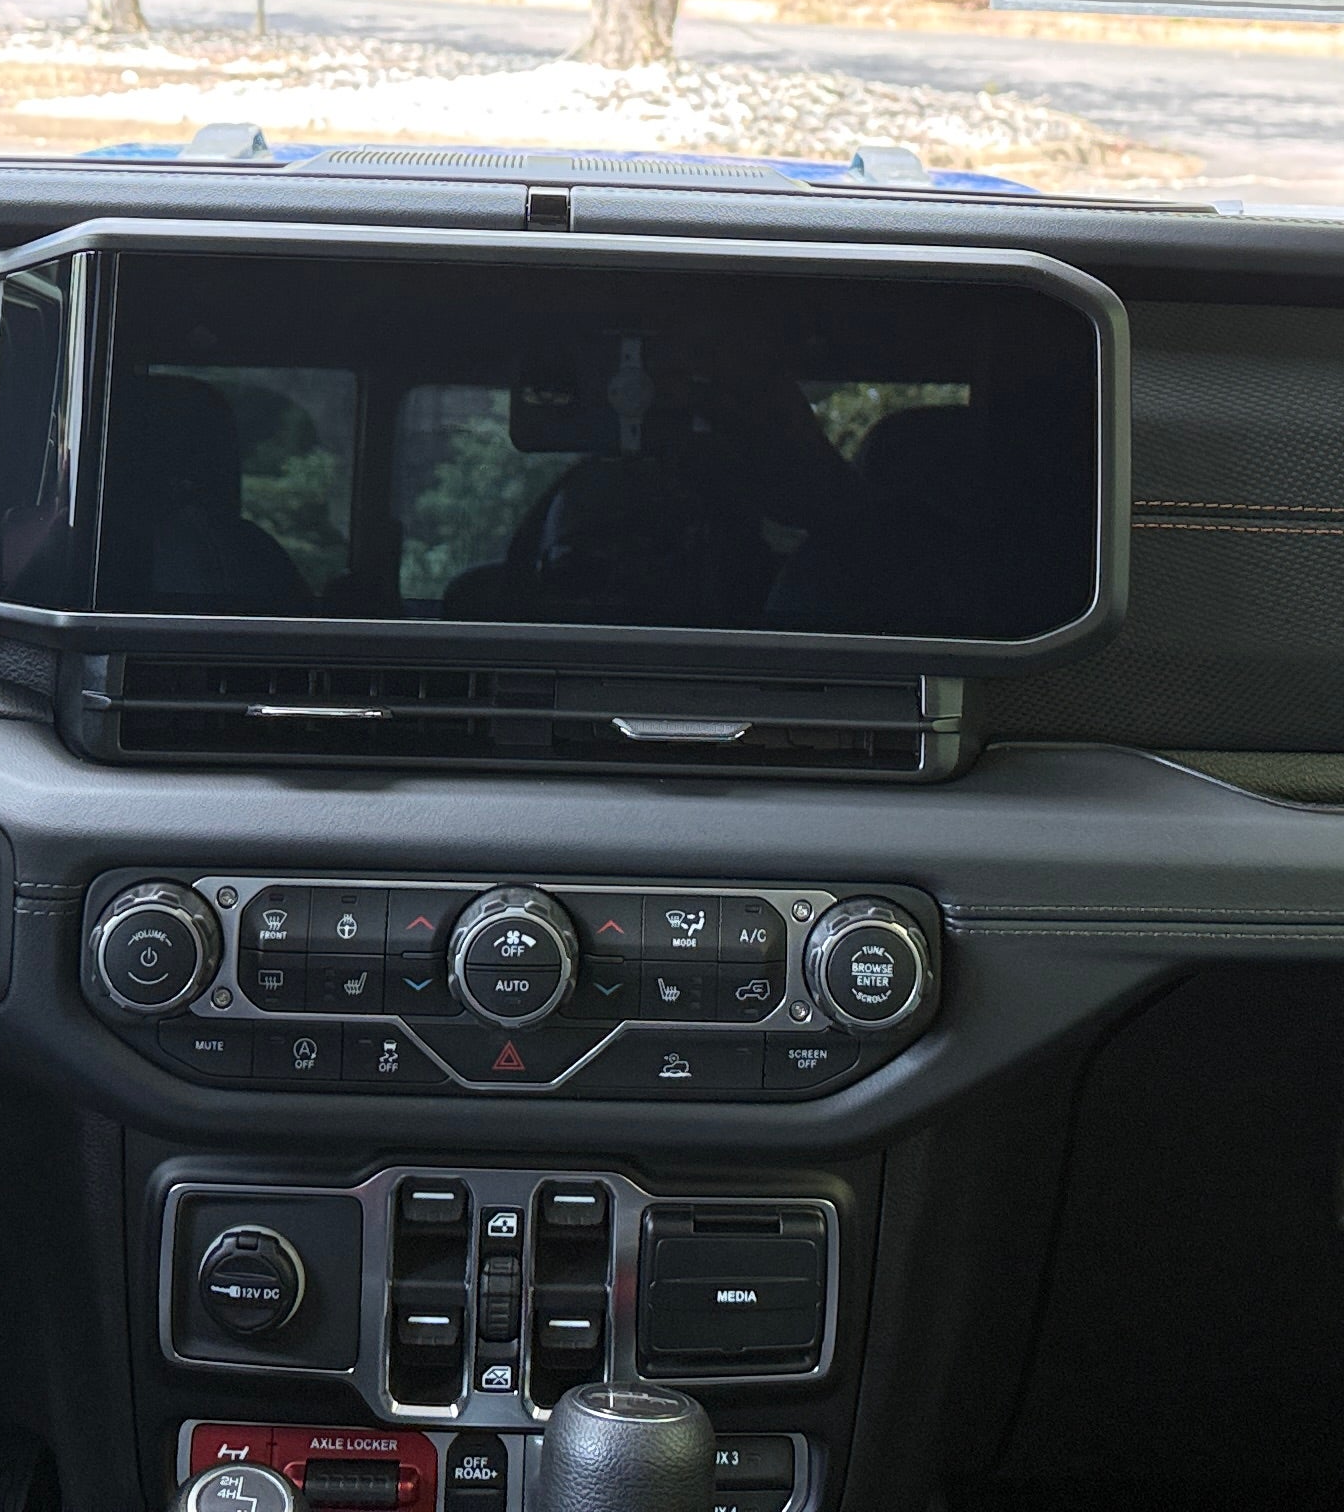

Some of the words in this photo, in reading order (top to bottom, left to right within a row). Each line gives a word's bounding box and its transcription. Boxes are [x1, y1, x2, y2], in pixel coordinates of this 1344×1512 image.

[132, 929, 167, 942] VOLUME
[259, 930, 287, 940] FRONT
[740, 928, 767, 944] A/C
[672, 938, 697, 948] MODE
[501, 946, 525, 957] OFF
[862, 945, 885, 956] TUNE
[851, 963, 893, 974] BROWSE
[496, 980, 529, 992] AUTO
[857, 977, 889, 987] ENTER
[855, 992, 888, 1004] SCROLL
[195, 1040, 224, 1051] MUTE
[788, 1050, 827, 1059] SCREEN
[295, 1060, 314, 1069] OFF
[378, 1062, 398, 1072] OFF
[798, 1060, 816, 1068] OFF
[241, 1288, 262, 1299] 12V
[264, 1289, 280, 1300] DC
[716, 1290, 757, 1303] MEDIA
[309, 1438, 342, 1451] AXLE
[345, 1438, 398, 1453] LOCKER
[463, 1457, 488, 1468] OFF
[730, 1451, 739, 1464] 3
[455, 1468, 498, 1480] ROAD+
[220, 1476, 238, 1486] 2H
[217, 1488, 236, 1499] 4H
